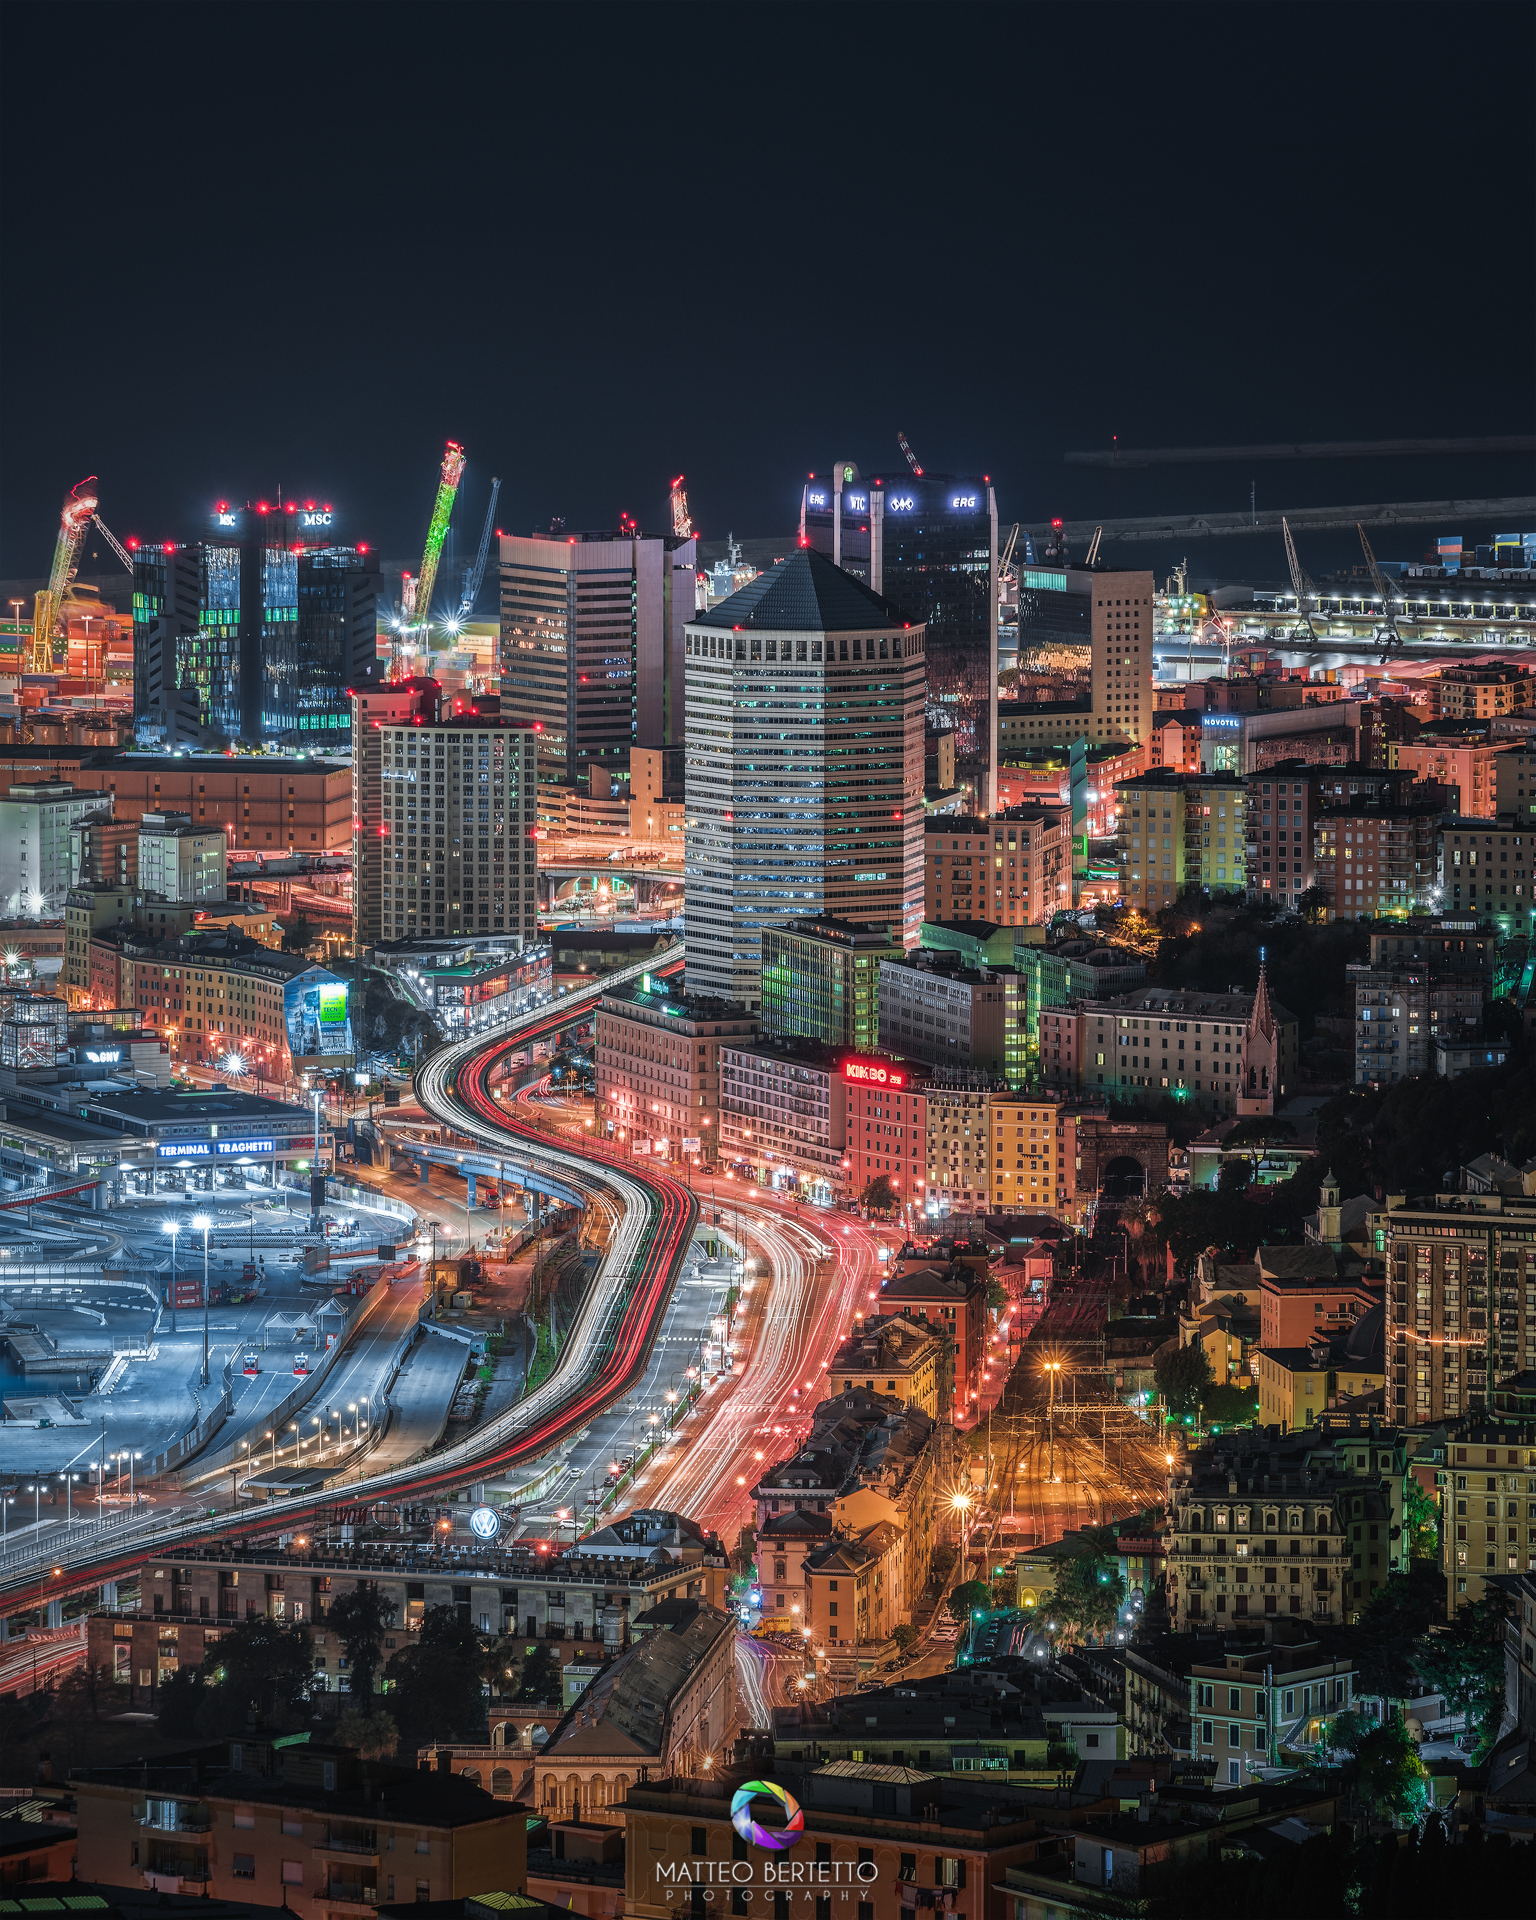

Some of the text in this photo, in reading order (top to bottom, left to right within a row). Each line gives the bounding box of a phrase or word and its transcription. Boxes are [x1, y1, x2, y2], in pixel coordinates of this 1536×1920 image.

[809, 494, 825, 505] ERG
[850, 496, 865, 510] WTC
[952, 497, 975, 507] ERG
[219, 514, 236, 526] MSC
[304, 514, 332, 526] MSC
[1204, 718, 1239, 727] NOVOTEL
[1071, 842, 1083, 850] RG
[99, 1051, 120, 1063] GNV
[846, 1063, 887, 1083] KIMBO
[159, 1140, 273, 1156] TERMINAL TRAGHETTI
[1221, 1584, 1296, 1594] MIRAMARE
